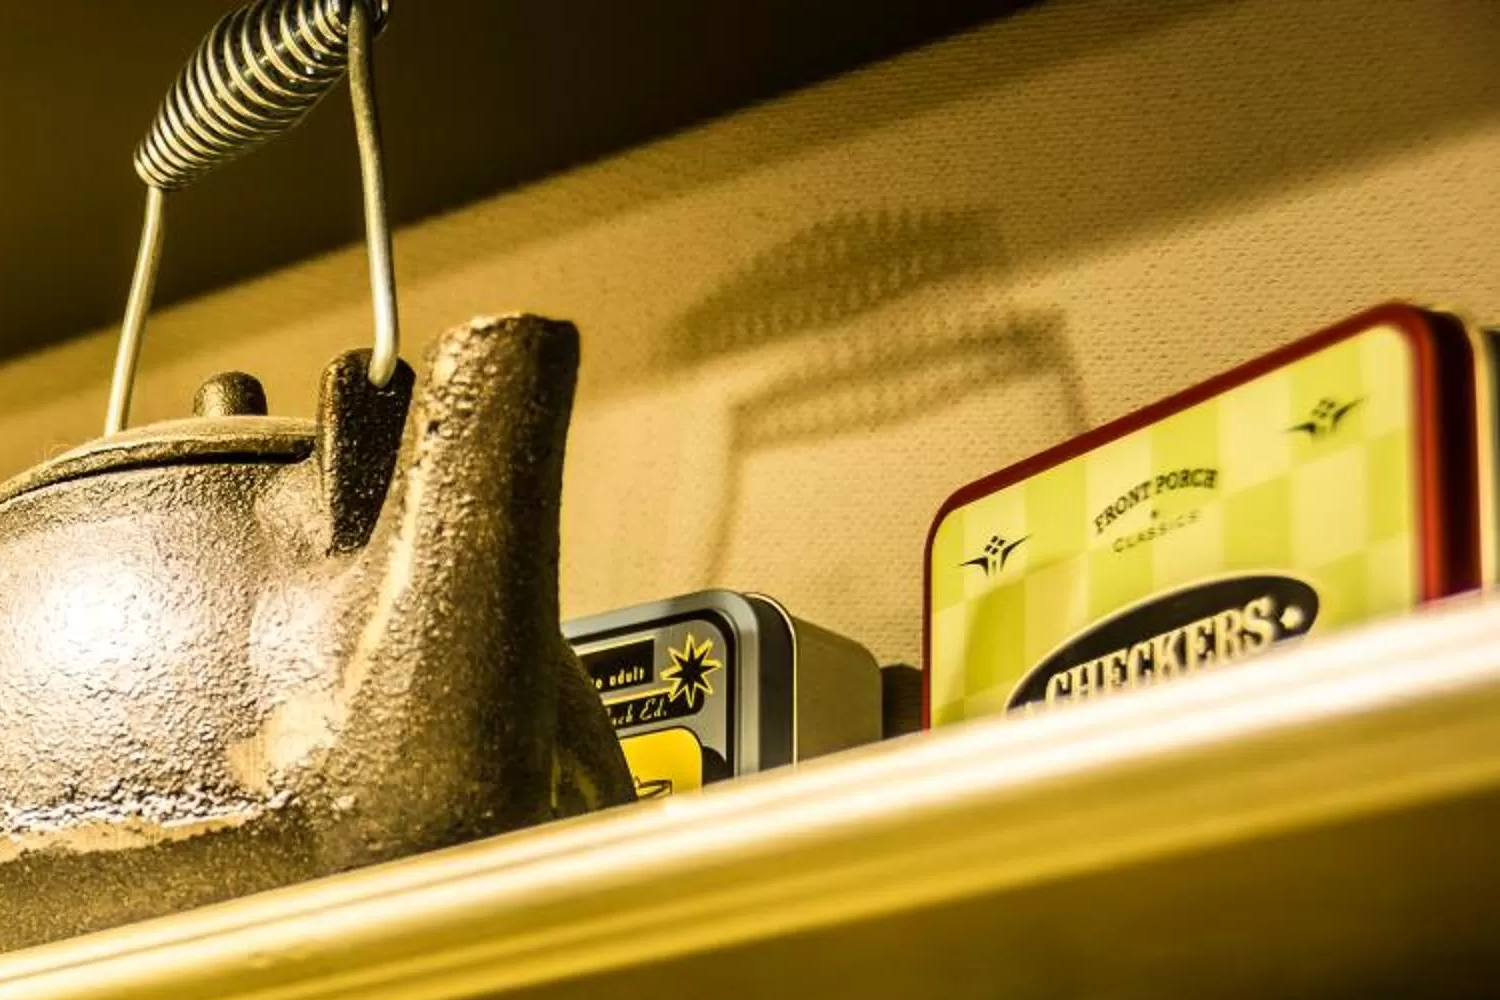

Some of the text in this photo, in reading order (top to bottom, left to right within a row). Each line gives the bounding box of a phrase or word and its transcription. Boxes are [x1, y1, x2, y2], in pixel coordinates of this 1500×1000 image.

[1094, 467, 1219, 535] FRONT PORCH
[1112, 510, 1201, 553] CLASSICS
[609, 666, 645, 686] adult
[1045, 595, 1278, 704] CHECKERS
